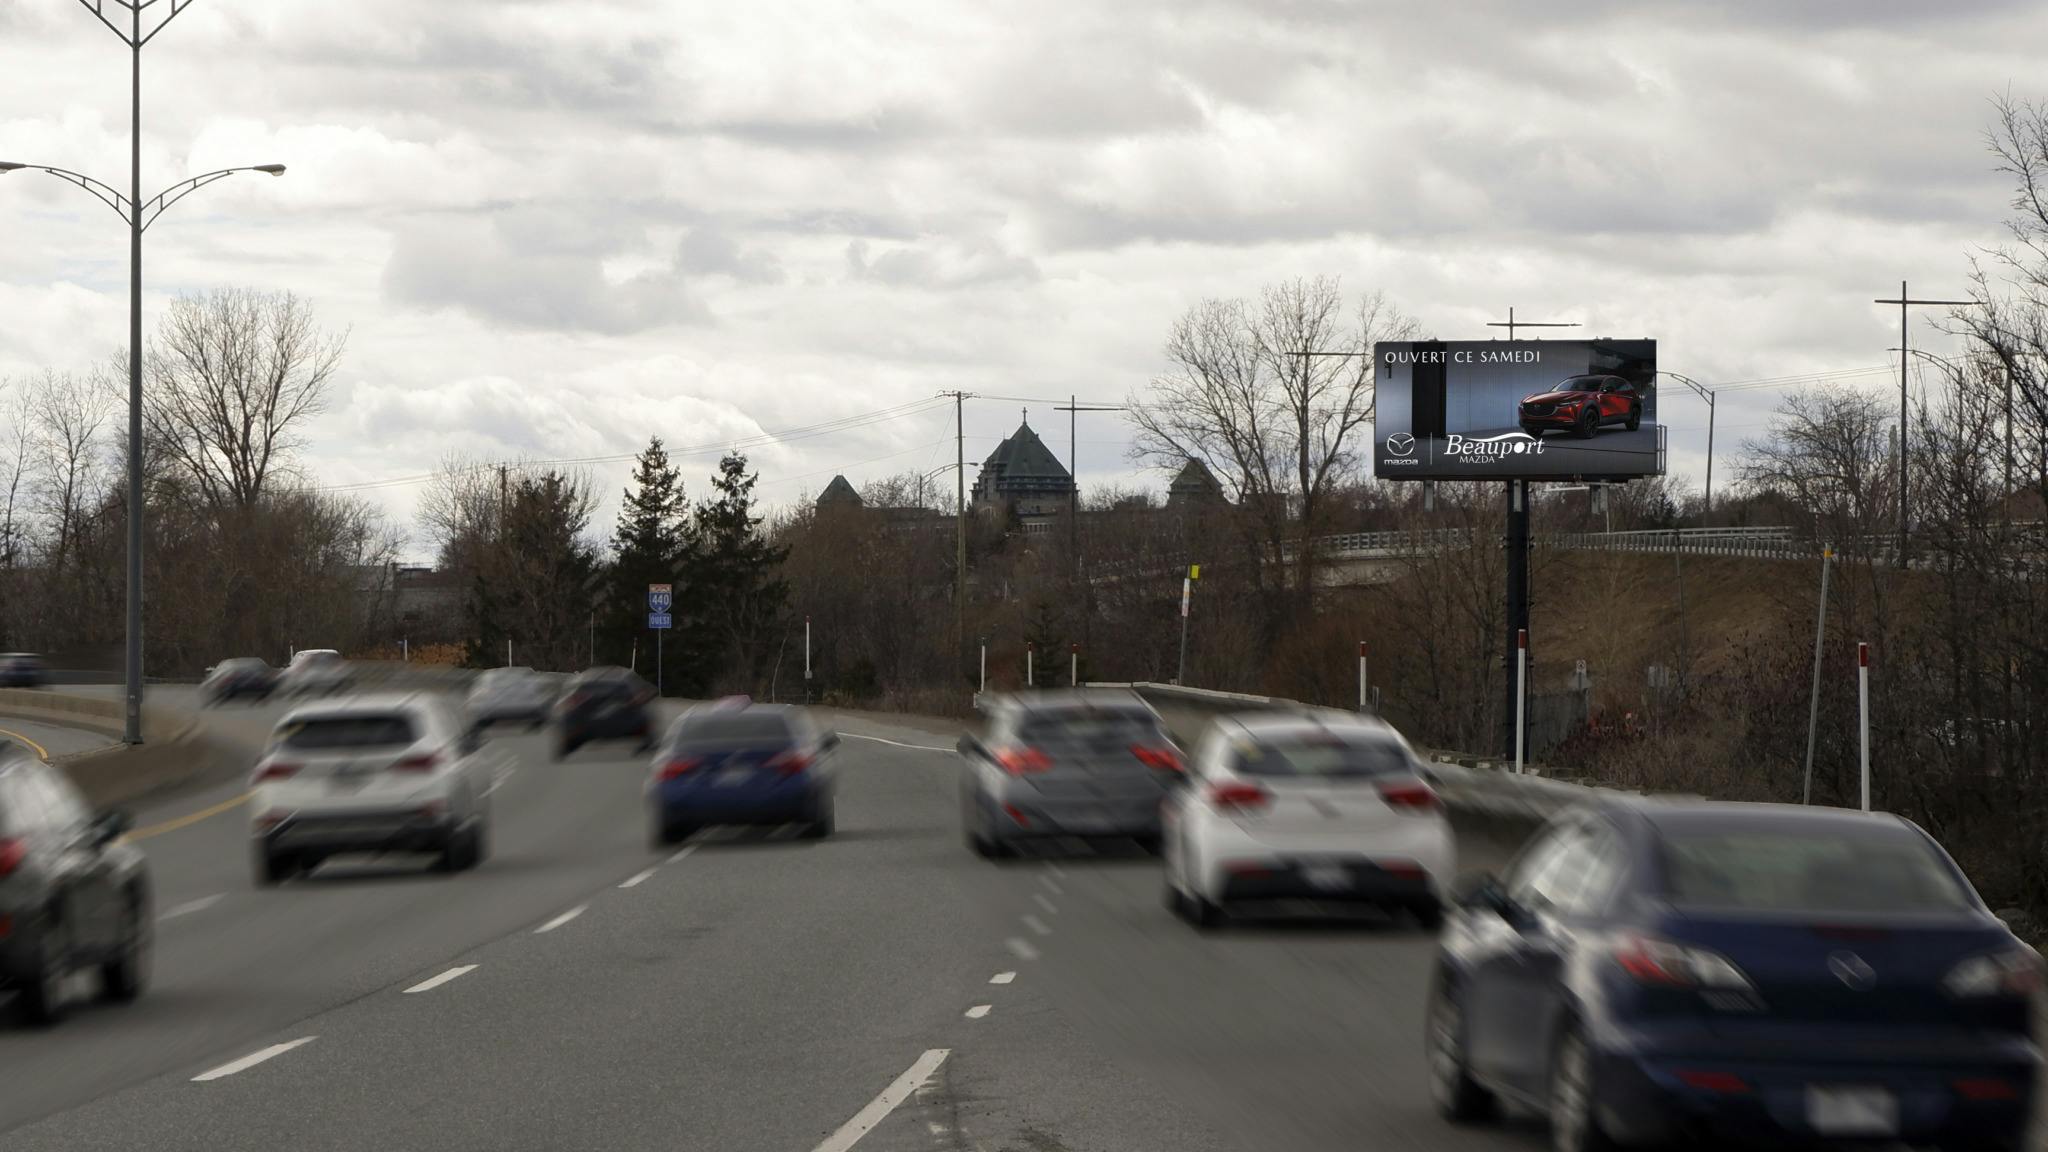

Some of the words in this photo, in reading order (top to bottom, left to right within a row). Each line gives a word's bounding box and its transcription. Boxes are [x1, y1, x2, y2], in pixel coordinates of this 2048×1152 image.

[1385, 351, 1447, 363] OUVERT
[1454, 351, 1473, 363] CE
[1480, 350, 1540, 363] SAMEDI
[1444, 433, 1545, 459] Beauport
[1459, 455, 1495, 464] MAZDA
[652, 595, 669, 605] 440
